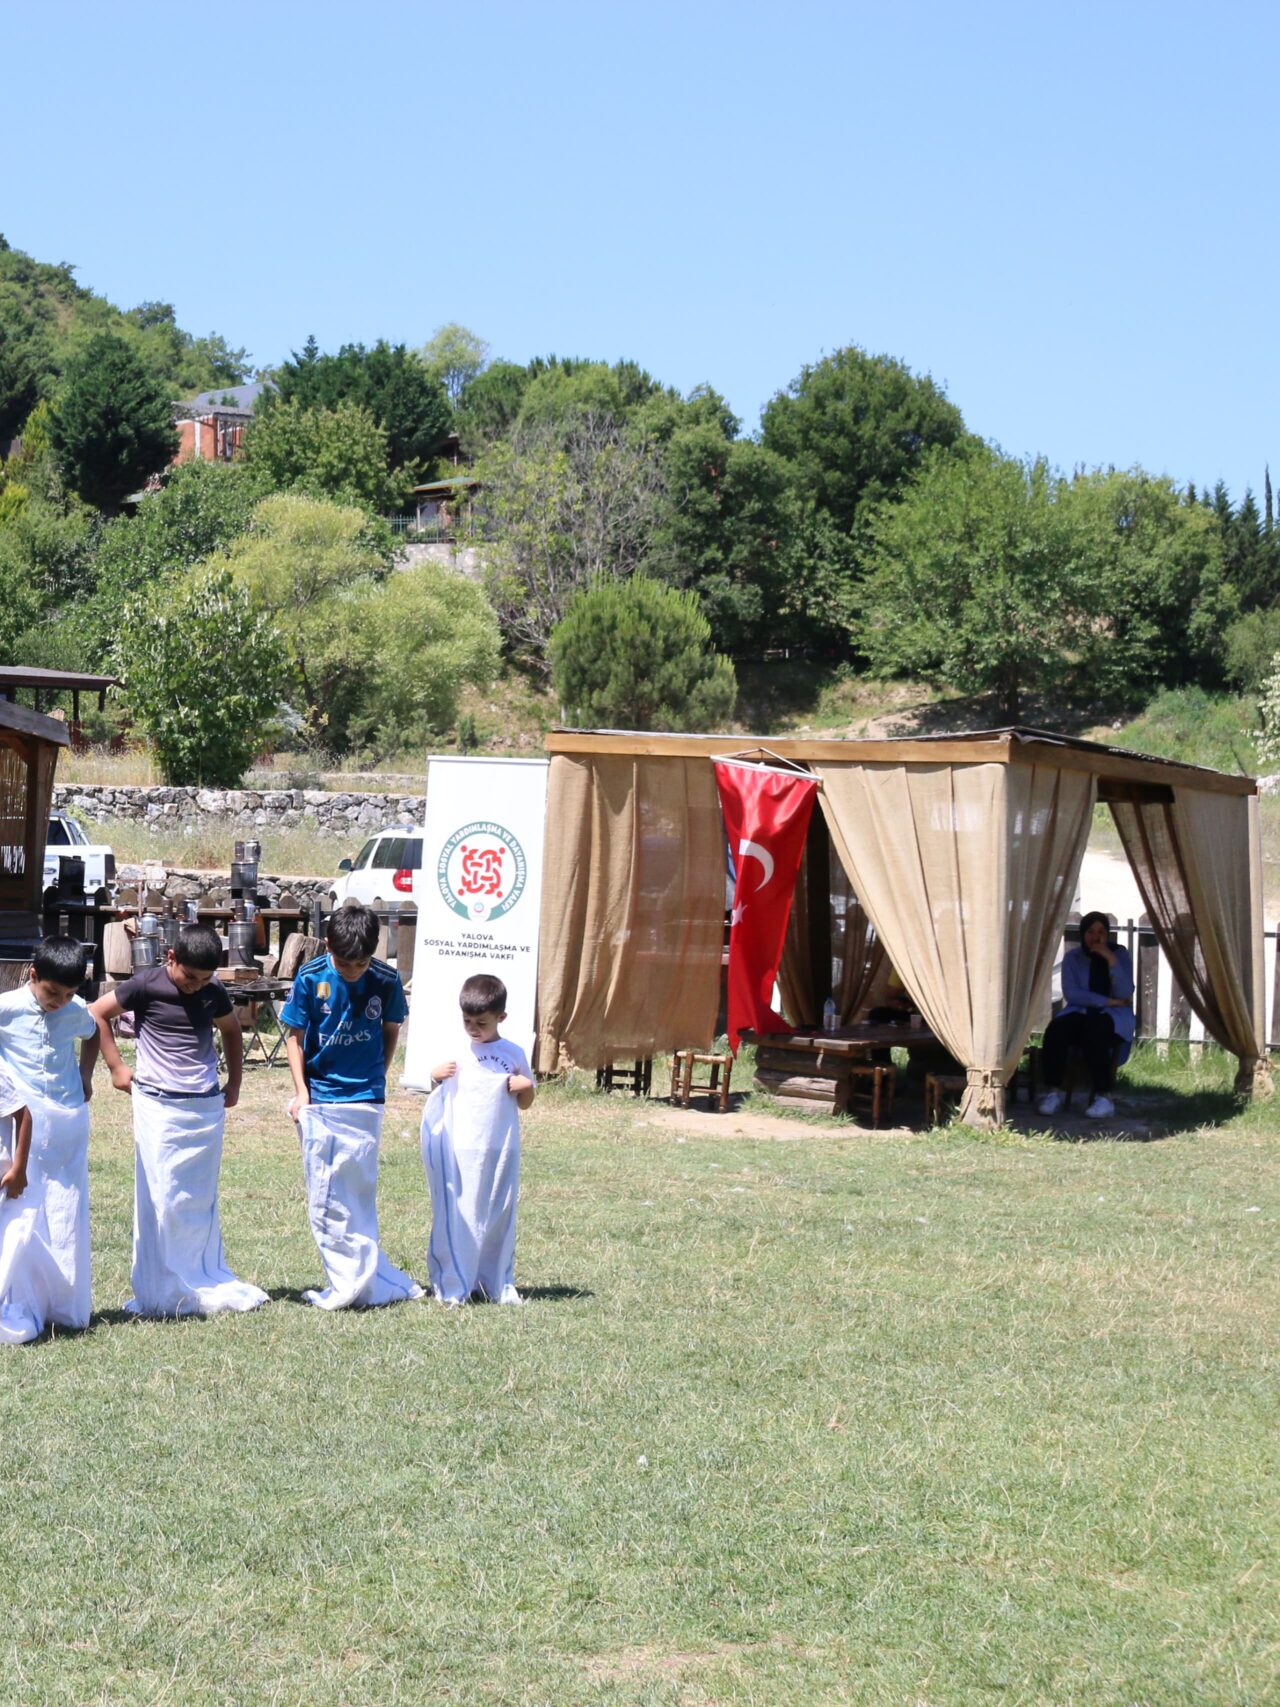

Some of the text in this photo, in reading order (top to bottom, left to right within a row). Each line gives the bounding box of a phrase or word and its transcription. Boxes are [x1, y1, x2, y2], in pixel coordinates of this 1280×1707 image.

[438, 823, 524, 912] YALOVA SOSYAL YARDIMLAŞMA VE DAYANIŞMA VAKFI
[461, 933, 494, 941] YALOVA
[424, 939, 455, 948] SOSYAL
[457, 942, 517, 953] YARDIMLAŞMA
[438, 949, 488, 959] DAYANIŞMA
